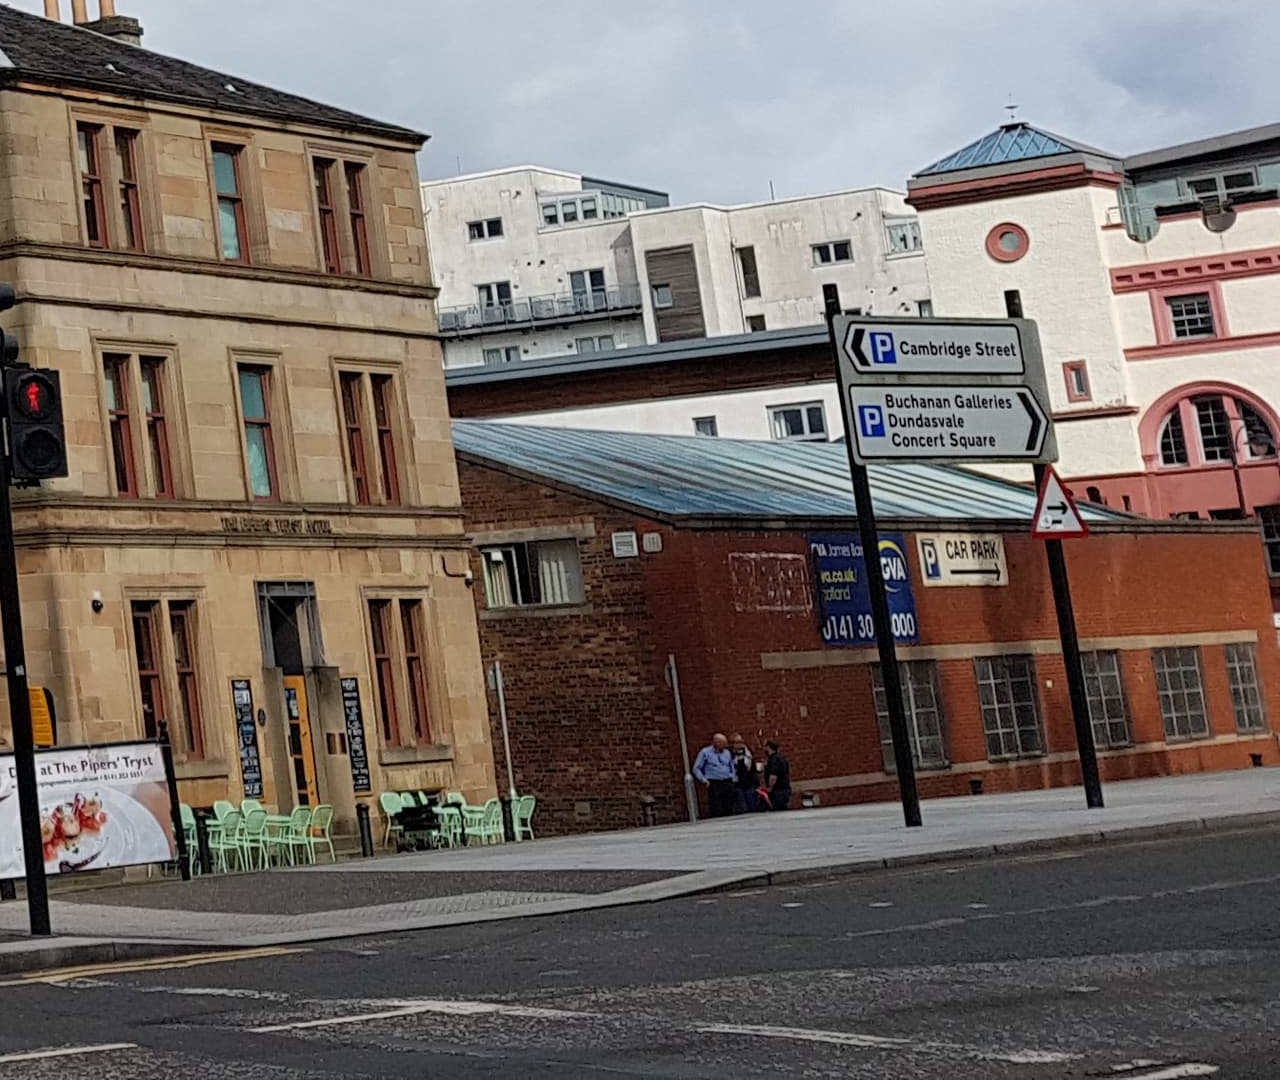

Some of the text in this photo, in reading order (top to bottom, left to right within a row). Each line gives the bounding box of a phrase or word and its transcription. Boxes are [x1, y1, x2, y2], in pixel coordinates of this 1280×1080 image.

[900, 340, 971, 359] Cambridge
[976, 341, 1017, 357] Street
[885, 394, 1013, 409] Buchanan Galleries
[888, 413, 965, 428] Dundasvale
[891, 433, 996, 450] Concert Square
[945, 539, 969, 560] CAR
[970, 539, 1000, 561] PARK
[880, 556, 907, 581] GVA
[40, 756, 154, 776] at The Pipers' Tryst
